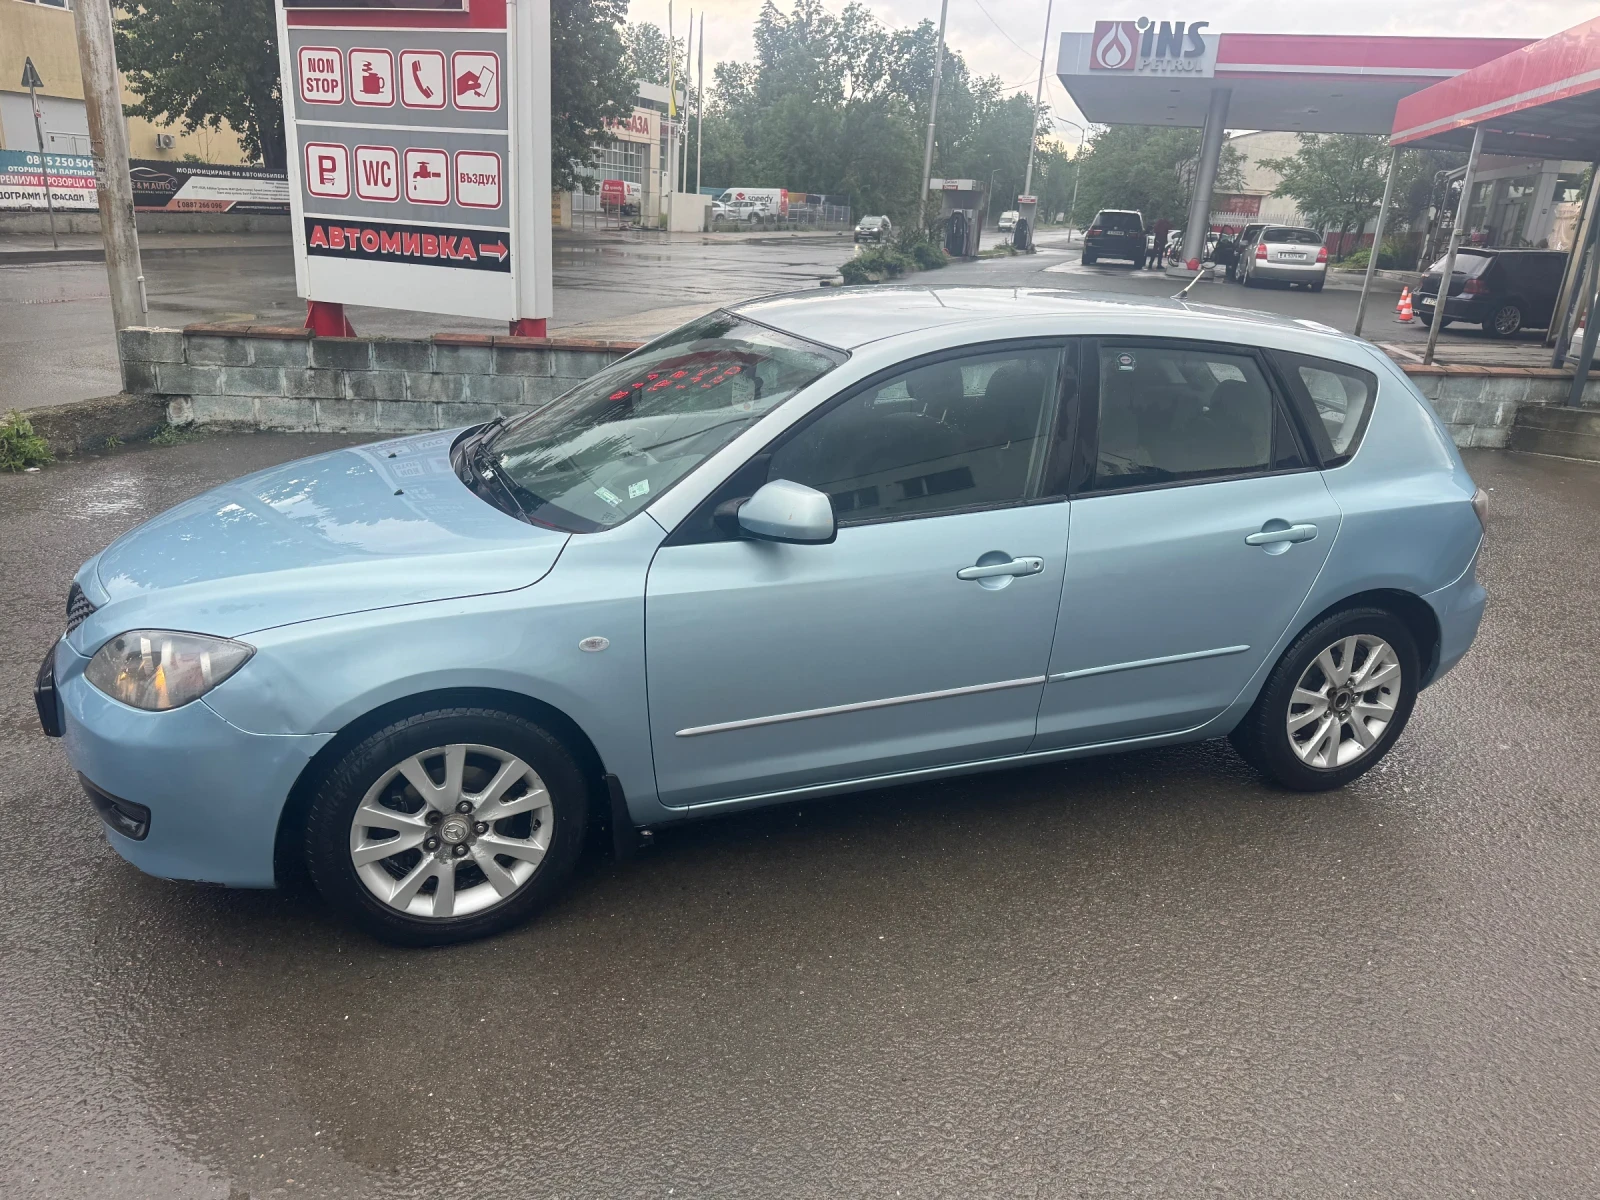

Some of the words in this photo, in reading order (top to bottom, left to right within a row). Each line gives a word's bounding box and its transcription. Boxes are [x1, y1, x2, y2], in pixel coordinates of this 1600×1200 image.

[307, 57, 335, 74] NON
[1138, 58, 1203, 72] PETROL
[306, 77, 339, 94] STOP
[54, 156, 75, 167] 250
[75, 158, 94, 168] 504
[7, 166, 57, 174] ОТОРИЗИАН
[242, 171, 285, 179] АВТОМОБИЛЕН
[317, 154, 337, 186] P
[362, 159, 392, 188] WC
[150, 182, 171, 191] AUTO
[181, 201, 198, 209] 0887
[747, 194, 774, 205] speedy
[309, 225, 479, 260] АВТОМИВКА
